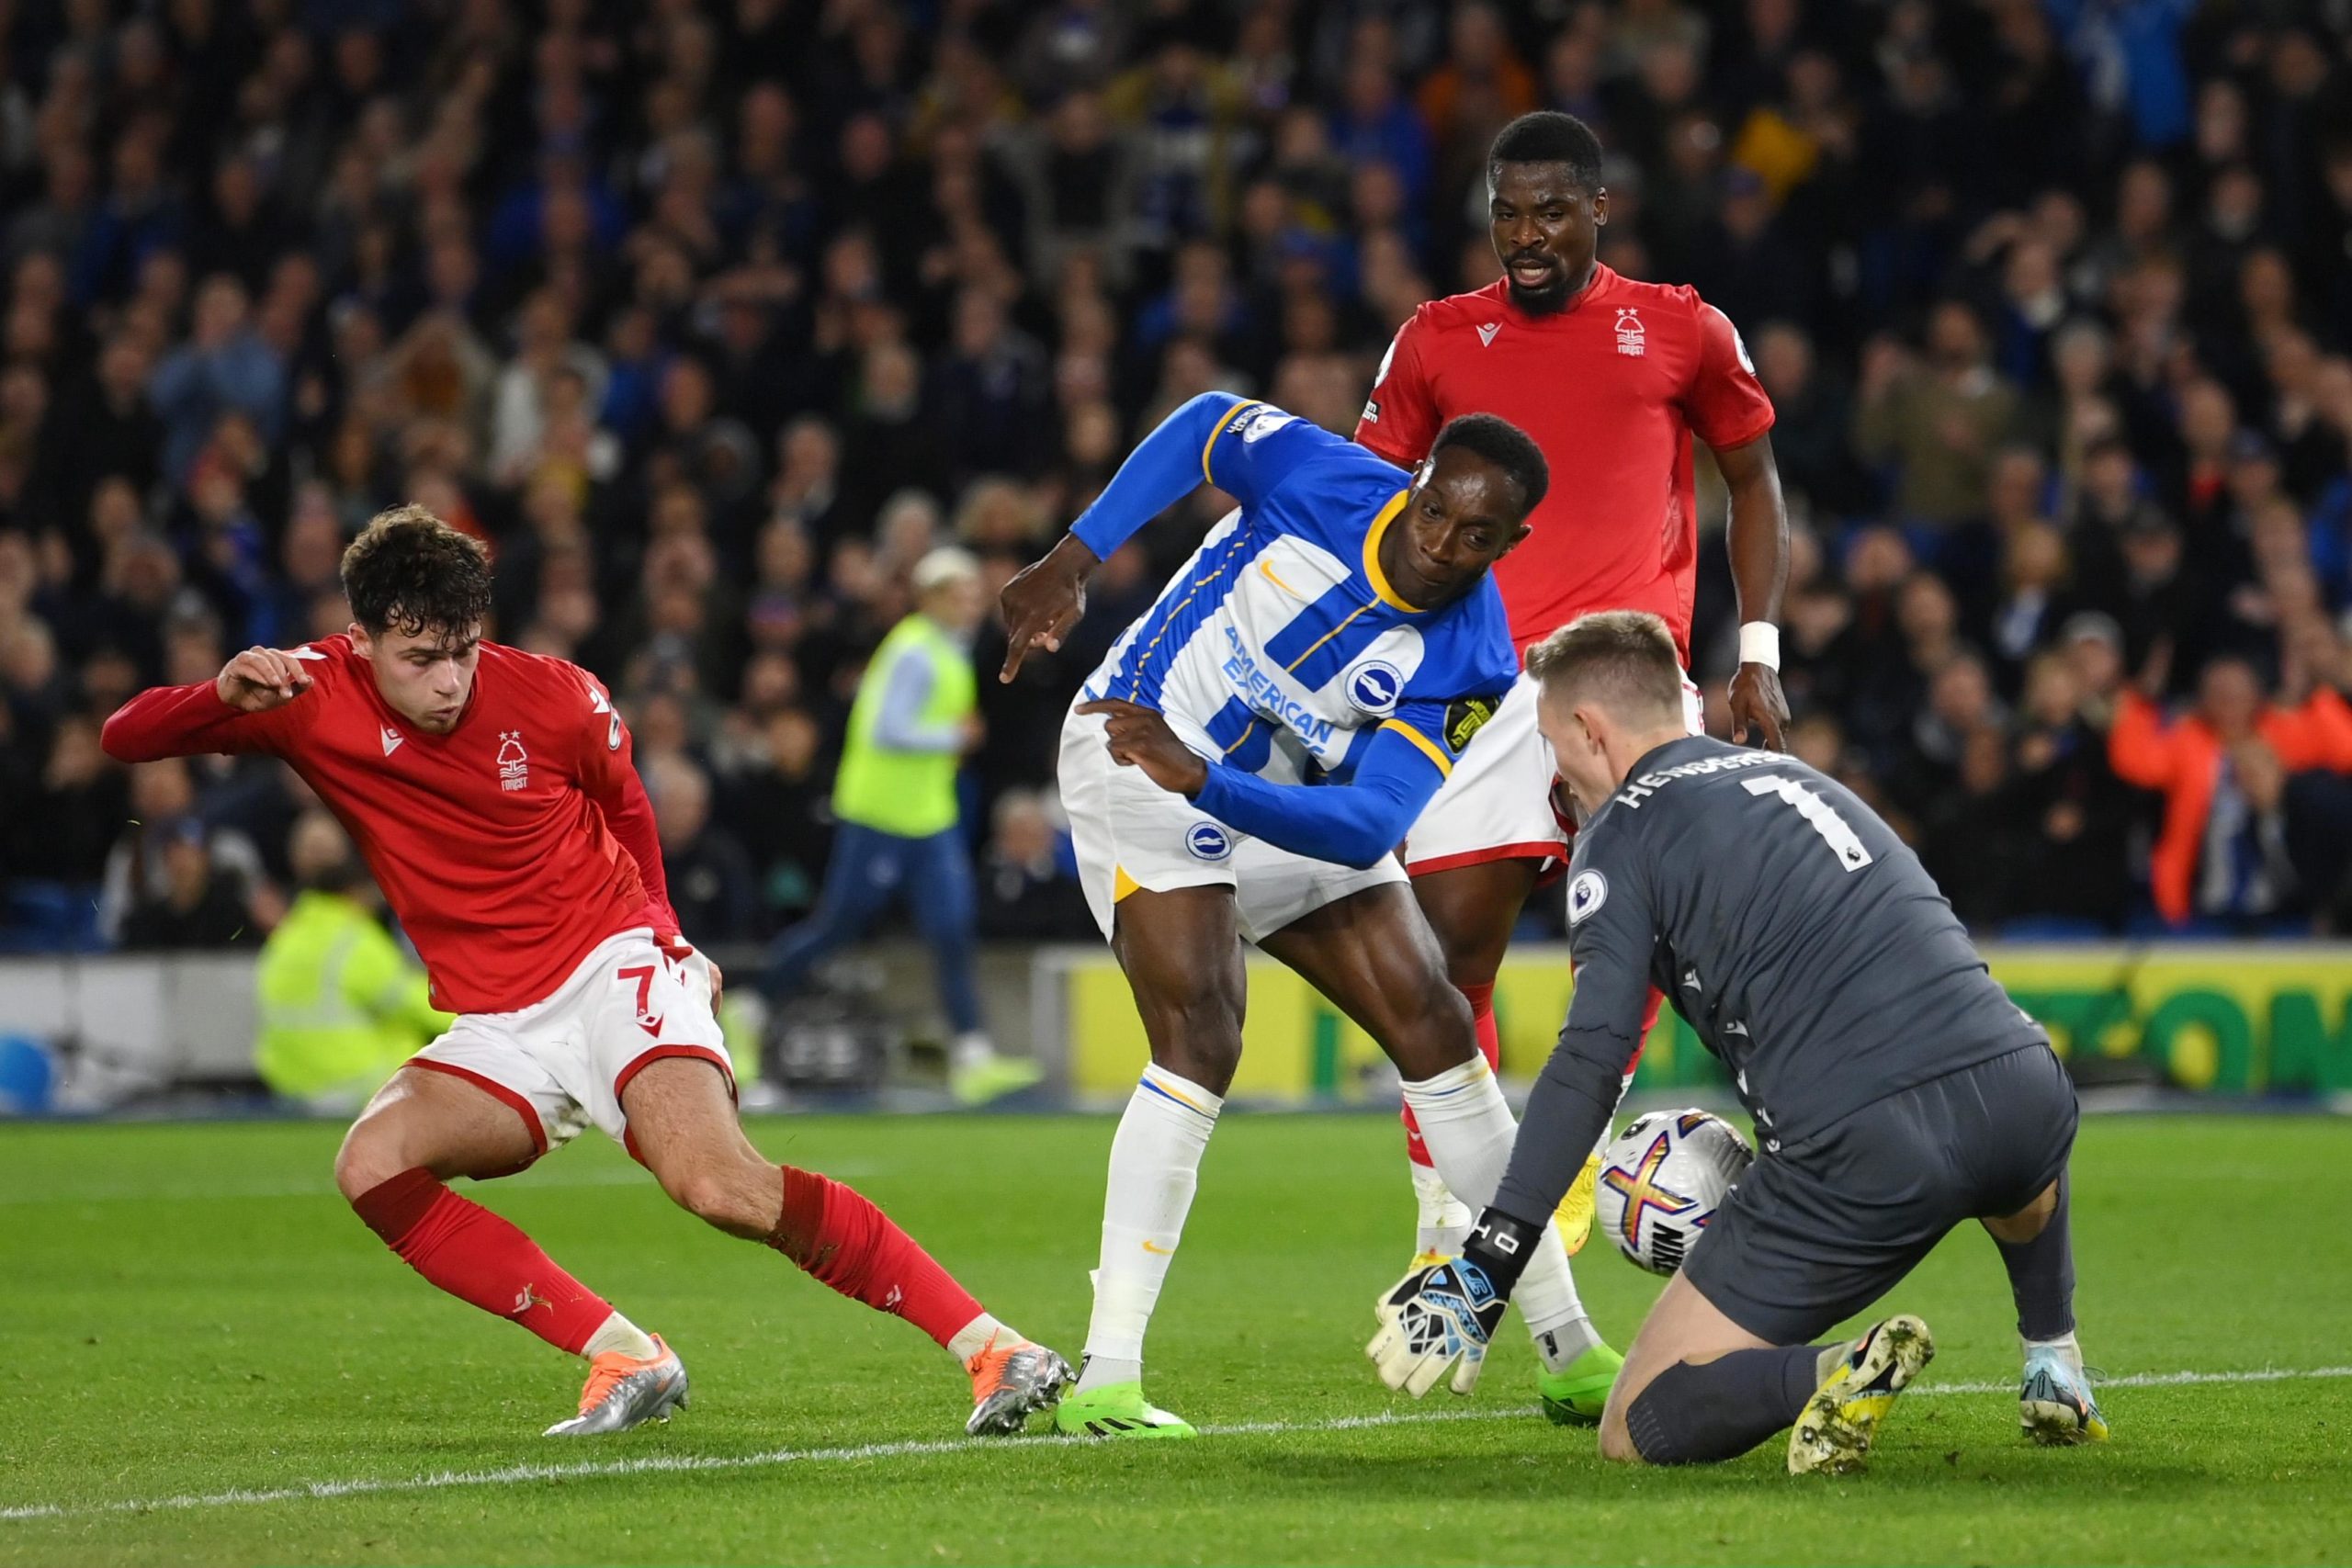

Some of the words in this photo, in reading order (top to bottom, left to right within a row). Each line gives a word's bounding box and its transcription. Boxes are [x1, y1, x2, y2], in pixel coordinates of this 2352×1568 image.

[1225, 626, 1335, 745] AMERICAN
[1615, 750, 1798, 810] HENDERS
[1740, 774, 1873, 873] 1
[617, 965, 656, 1018] 7
